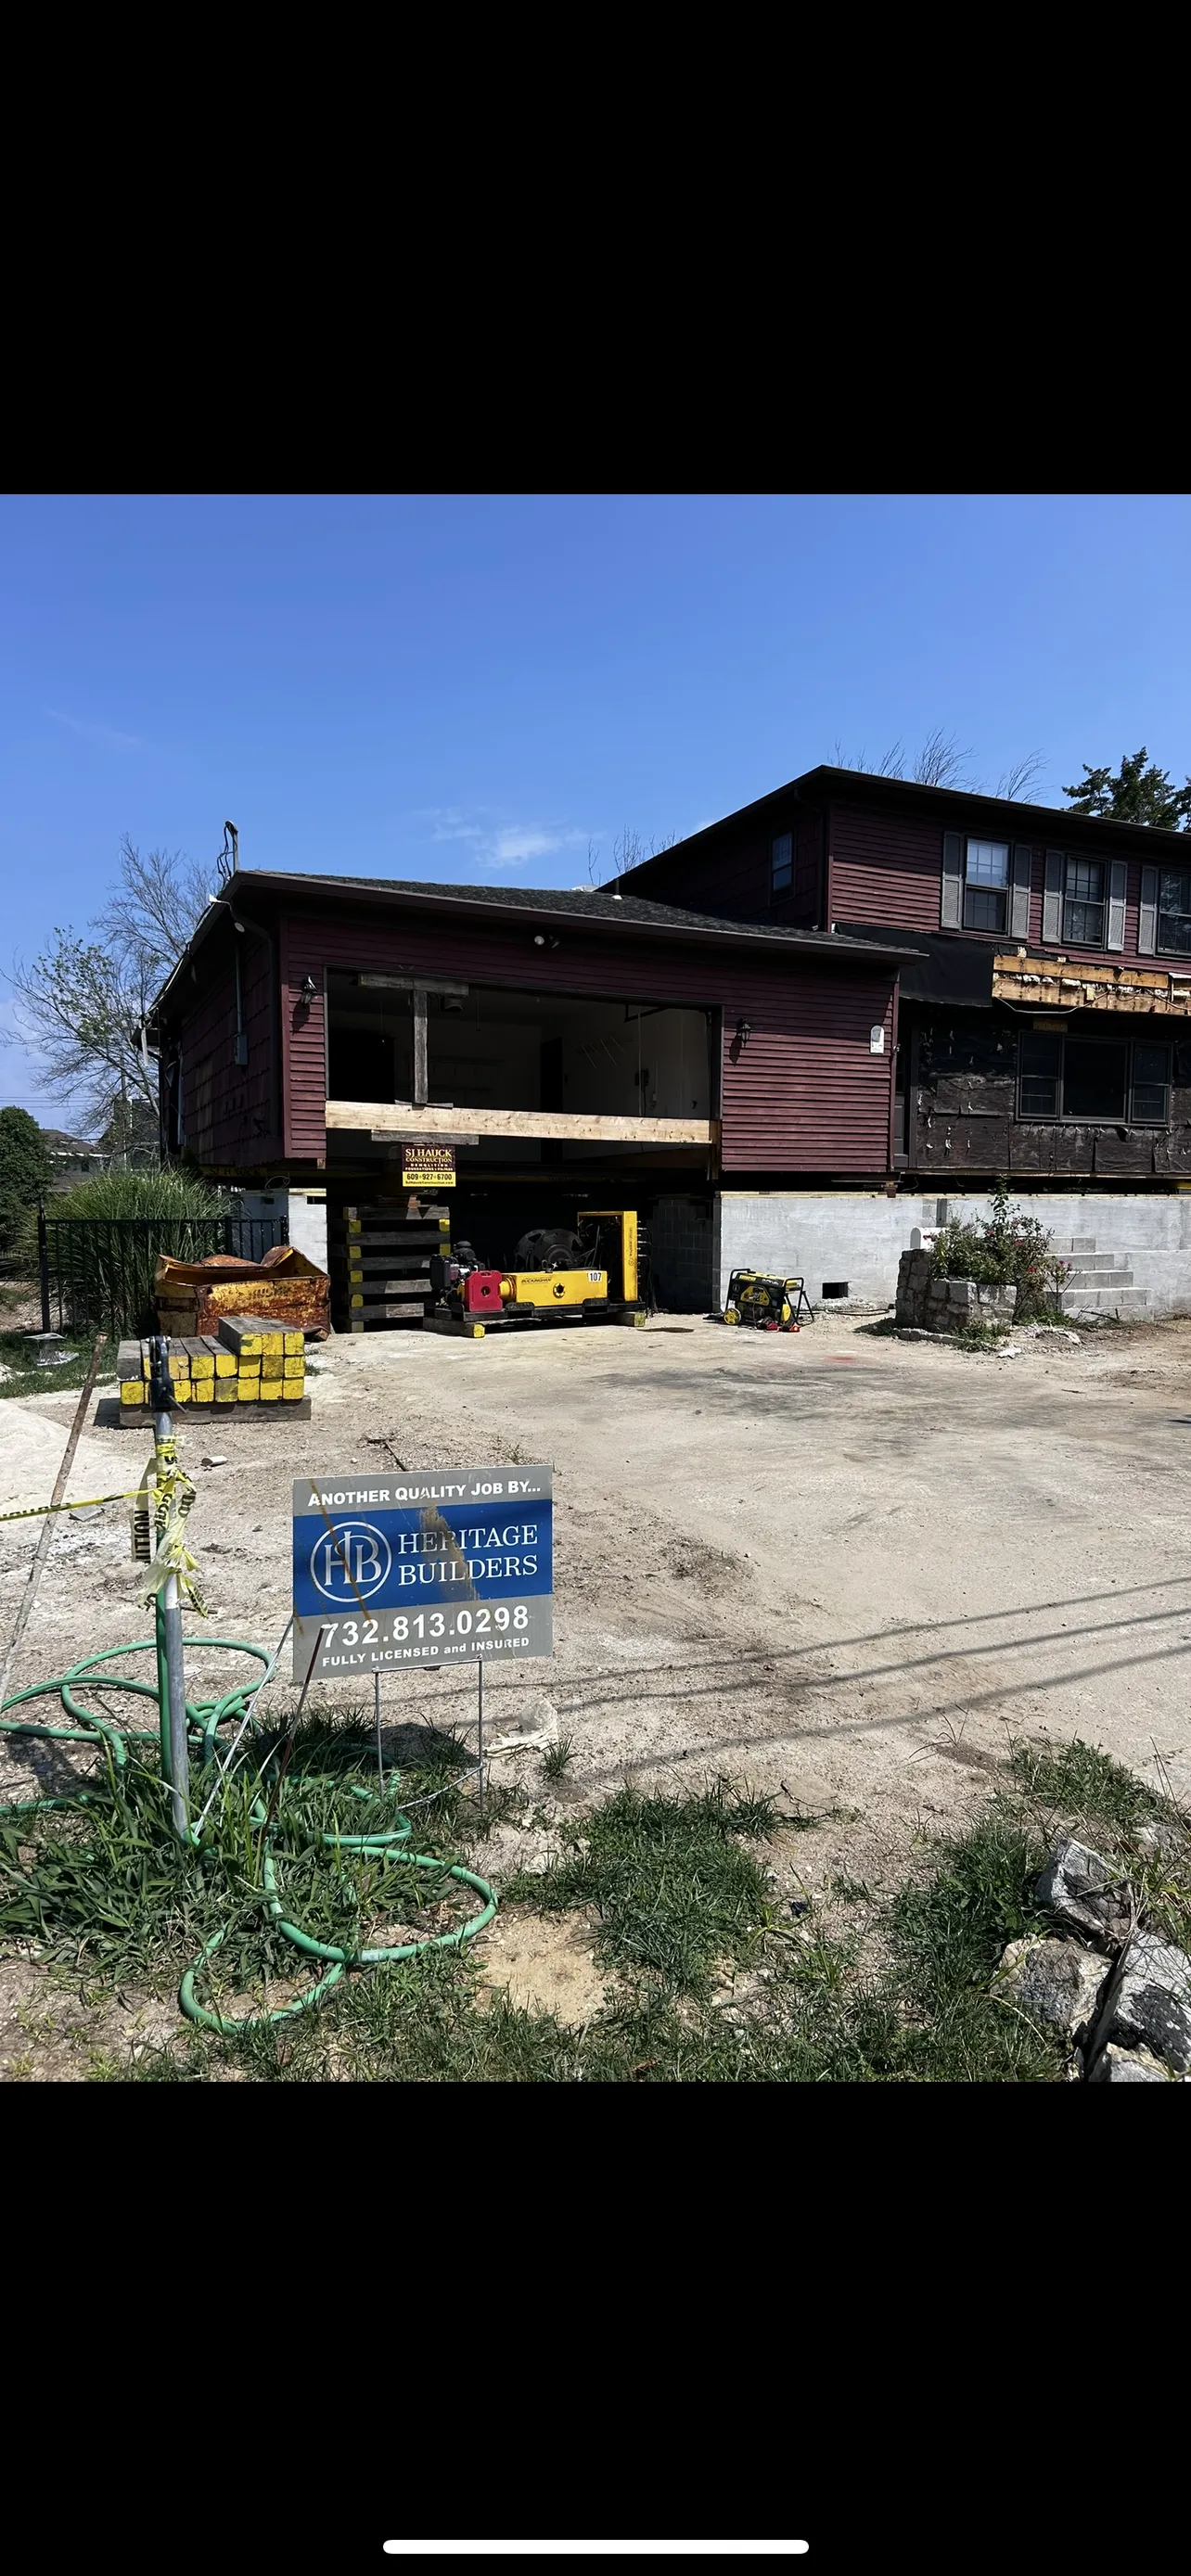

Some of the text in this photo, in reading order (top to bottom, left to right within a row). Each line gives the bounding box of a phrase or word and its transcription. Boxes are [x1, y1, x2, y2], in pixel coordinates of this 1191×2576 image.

[405, 1148, 453, 1158] SJ HAUCK
[590, 1272, 602, 1282] 107
[308, 1480, 541, 1507] ANOTHER QUALITY JOB BY...
[398, 1524, 538, 1555] HERITAGE
[398, 1554, 538, 1587] BUILDERS
[321, 1604, 530, 1649] 732.813.0298
[322, 1637, 530, 1667] FULLY LICENSED and INSURED
